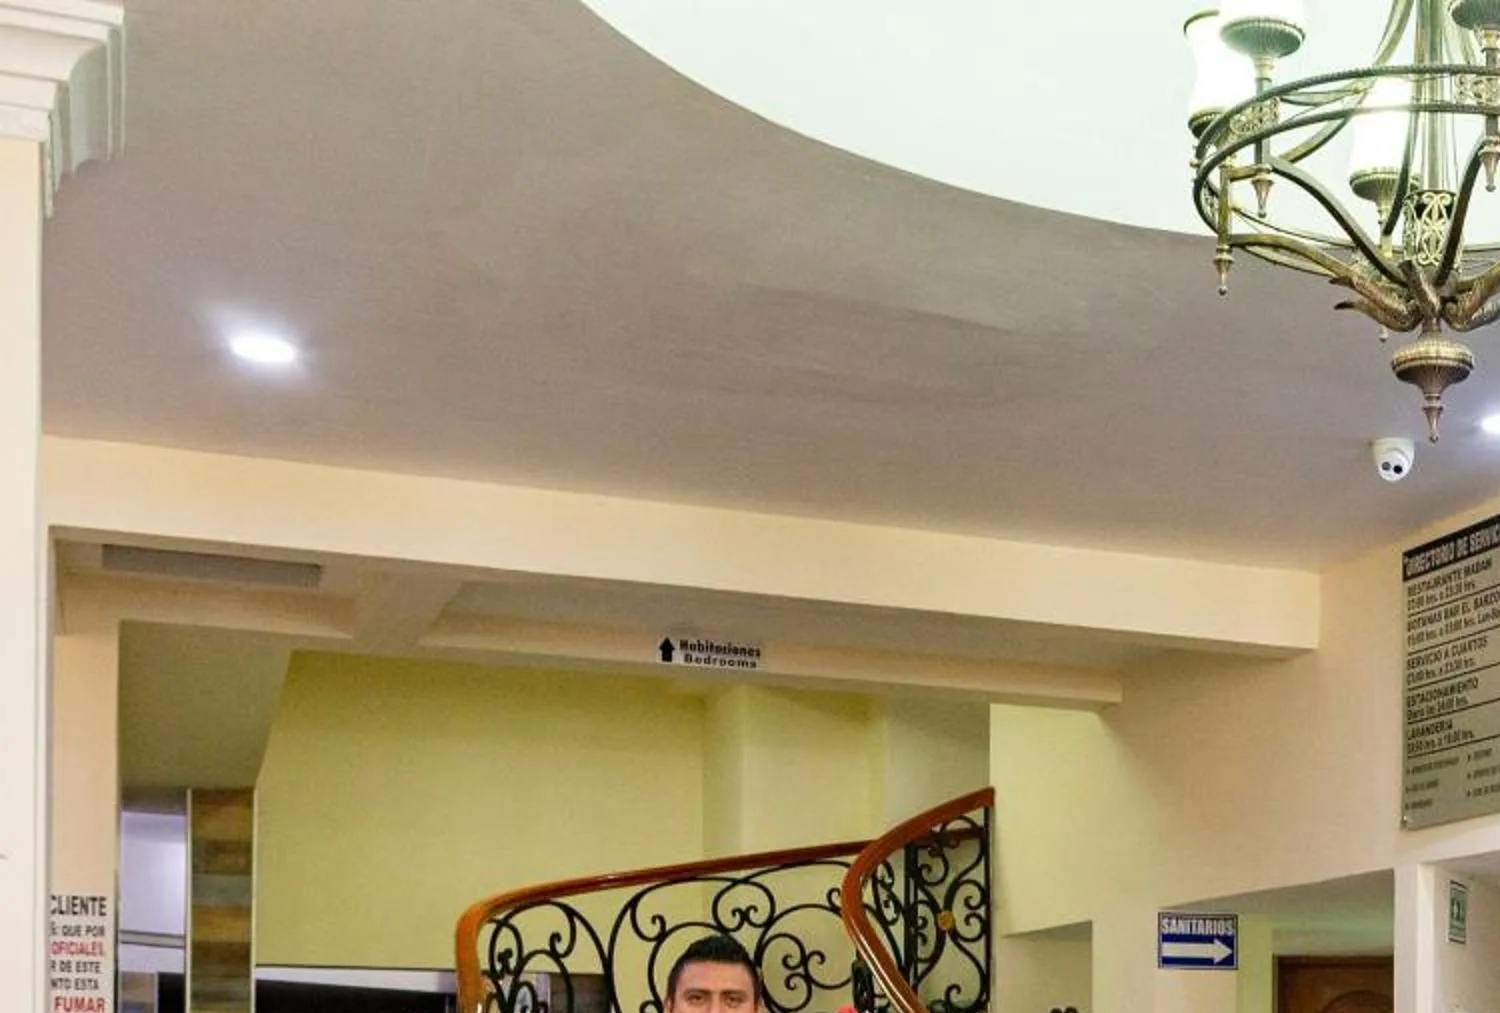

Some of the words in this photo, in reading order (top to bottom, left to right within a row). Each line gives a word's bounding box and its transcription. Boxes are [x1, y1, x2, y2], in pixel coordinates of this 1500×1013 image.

[1407, 539, 1453, 577] DIRECTORIO
[1457, 535, 1468, 557] DE
[1408, 565, 1462, 598] RESTAURANTE
[1444, 602, 1460, 620] BAR
[680, 639, 761, 658] Habitaciones
[1407, 648, 1442, 671] SERVICIO
[1452, 633, 1488, 658] CUARTOS
[684, 653, 757, 668] Bedrooms
[1408, 675, 1478, 708] ESTACIONAMIENTO
[51, 895, 107, 917] CLIENTE
[62, 924, 81, 937] QUE
[85, 924, 105, 938] POR
[1161, 917, 1234, 936] SANITARIOS
[51, 940, 105, 956] OFICIALES
[60, 960, 72, 973] DE
[75, 961, 101, 974] ESTE
[54, 996, 105, 1013] FUMAR
